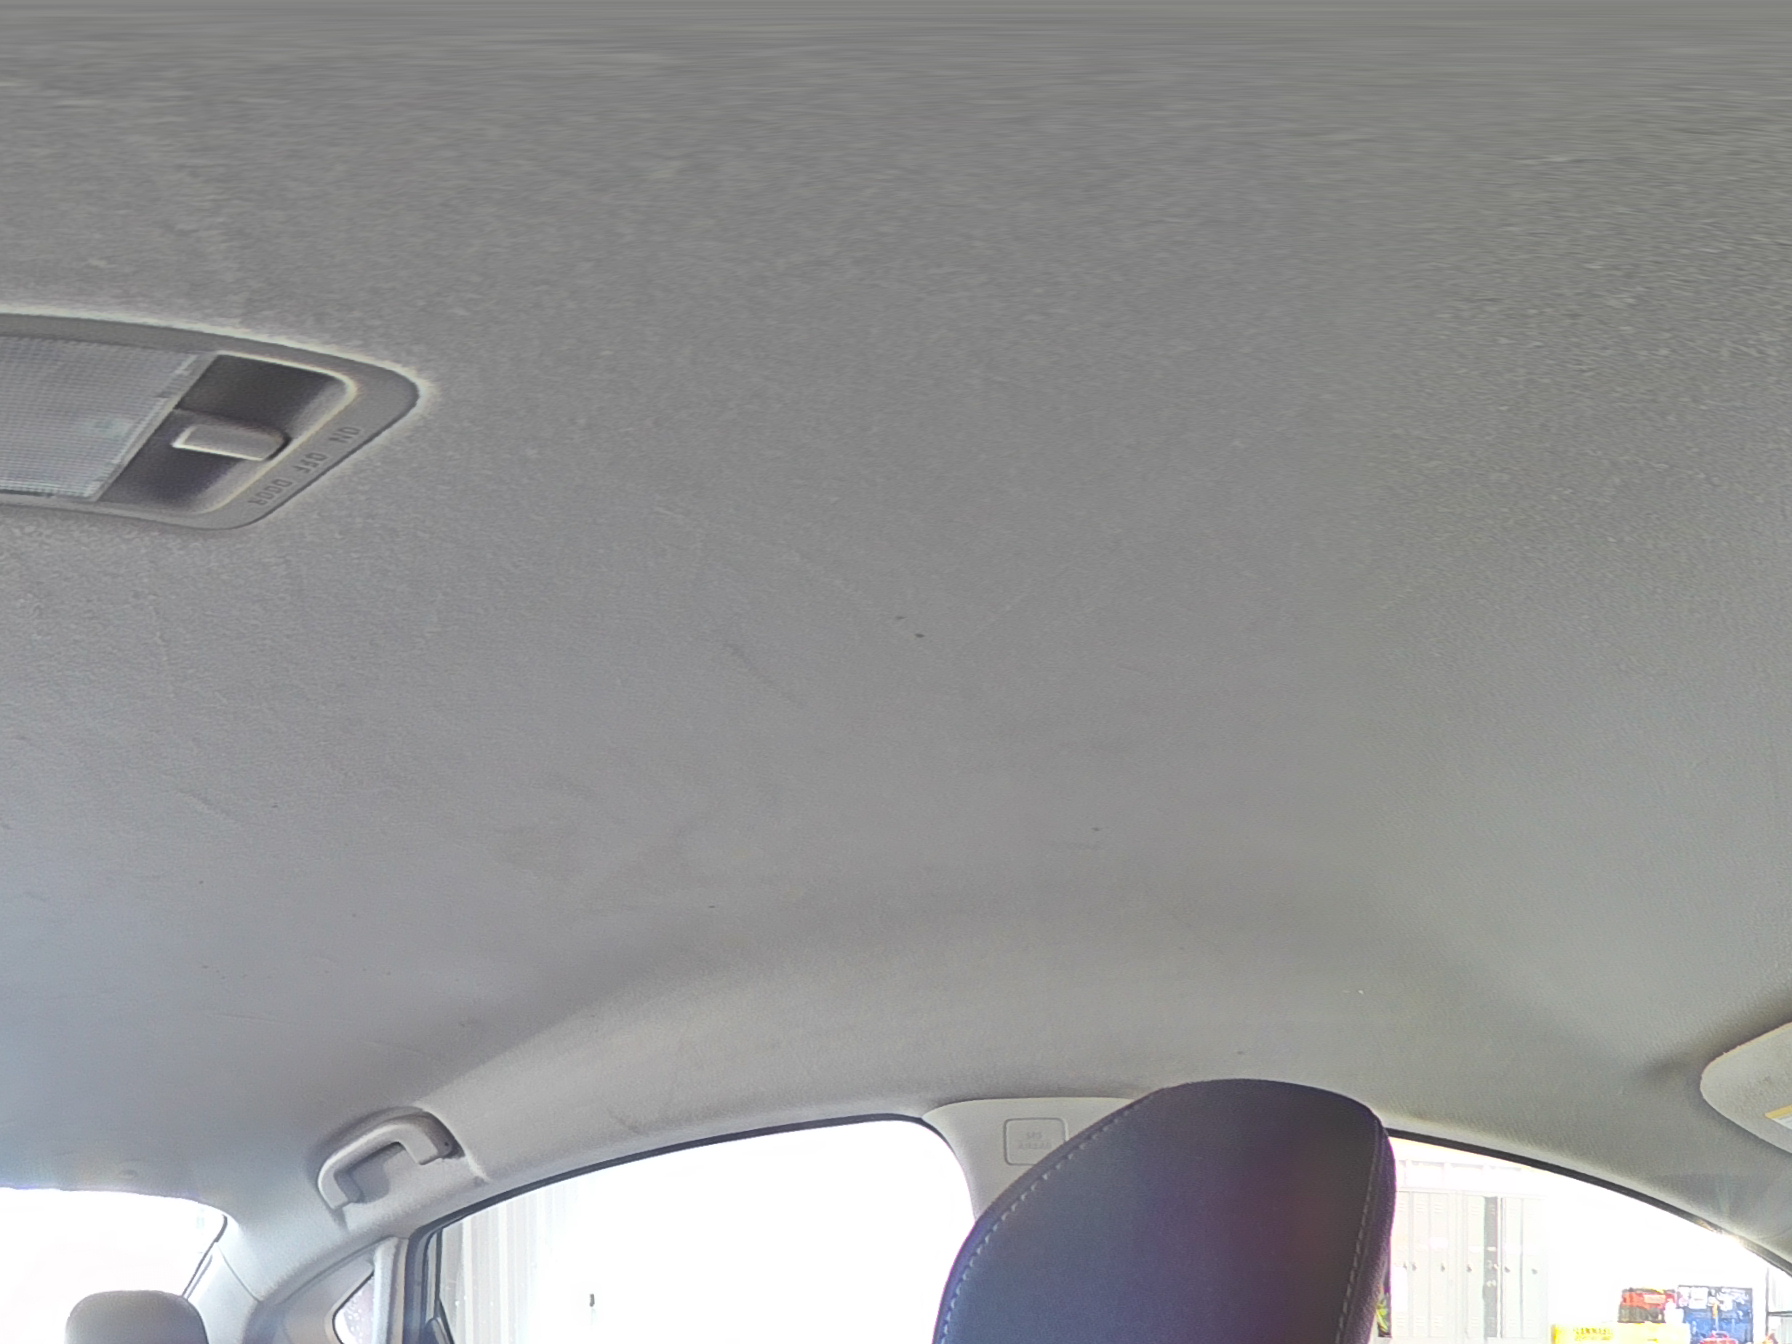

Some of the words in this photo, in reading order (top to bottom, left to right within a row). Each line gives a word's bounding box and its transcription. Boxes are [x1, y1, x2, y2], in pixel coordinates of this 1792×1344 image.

[328, 426, 360, 443] ON
[292, 452, 329, 474] OFF
[247, 478, 293, 506] DOOR
